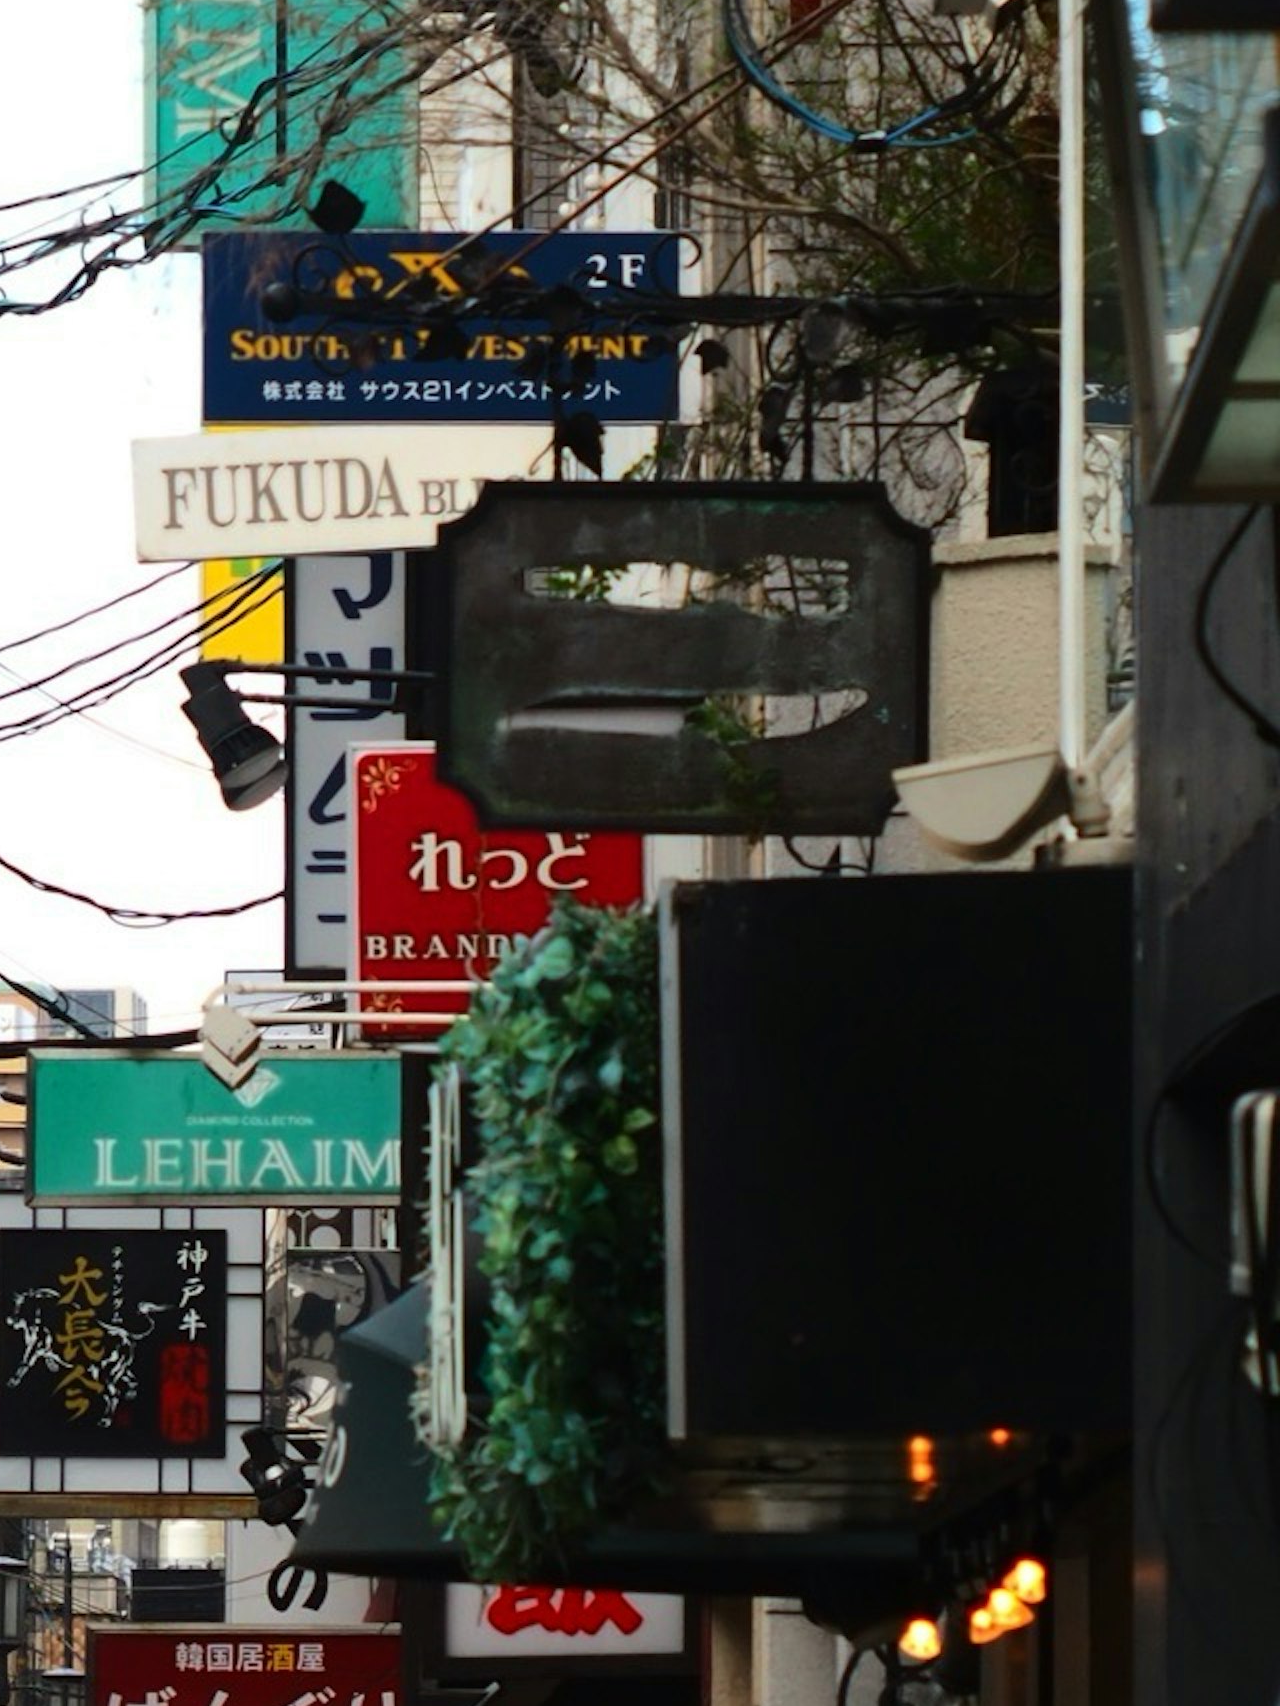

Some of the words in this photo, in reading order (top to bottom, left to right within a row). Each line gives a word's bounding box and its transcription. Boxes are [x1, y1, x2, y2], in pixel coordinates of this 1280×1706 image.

[262, 379, 346, 402] 株式会社
[359, 378, 622, 402] サウス21インベストント
[161, 456, 410, 530] FUKUDA
[242, 1115, 314, 1127] COLLECTION
[93, 1138, 401, 1187] LEHAIM
[176, 1239, 211, 1342] 神戸牛
[175, 1642, 327, 1673] 韓国居酒屋
